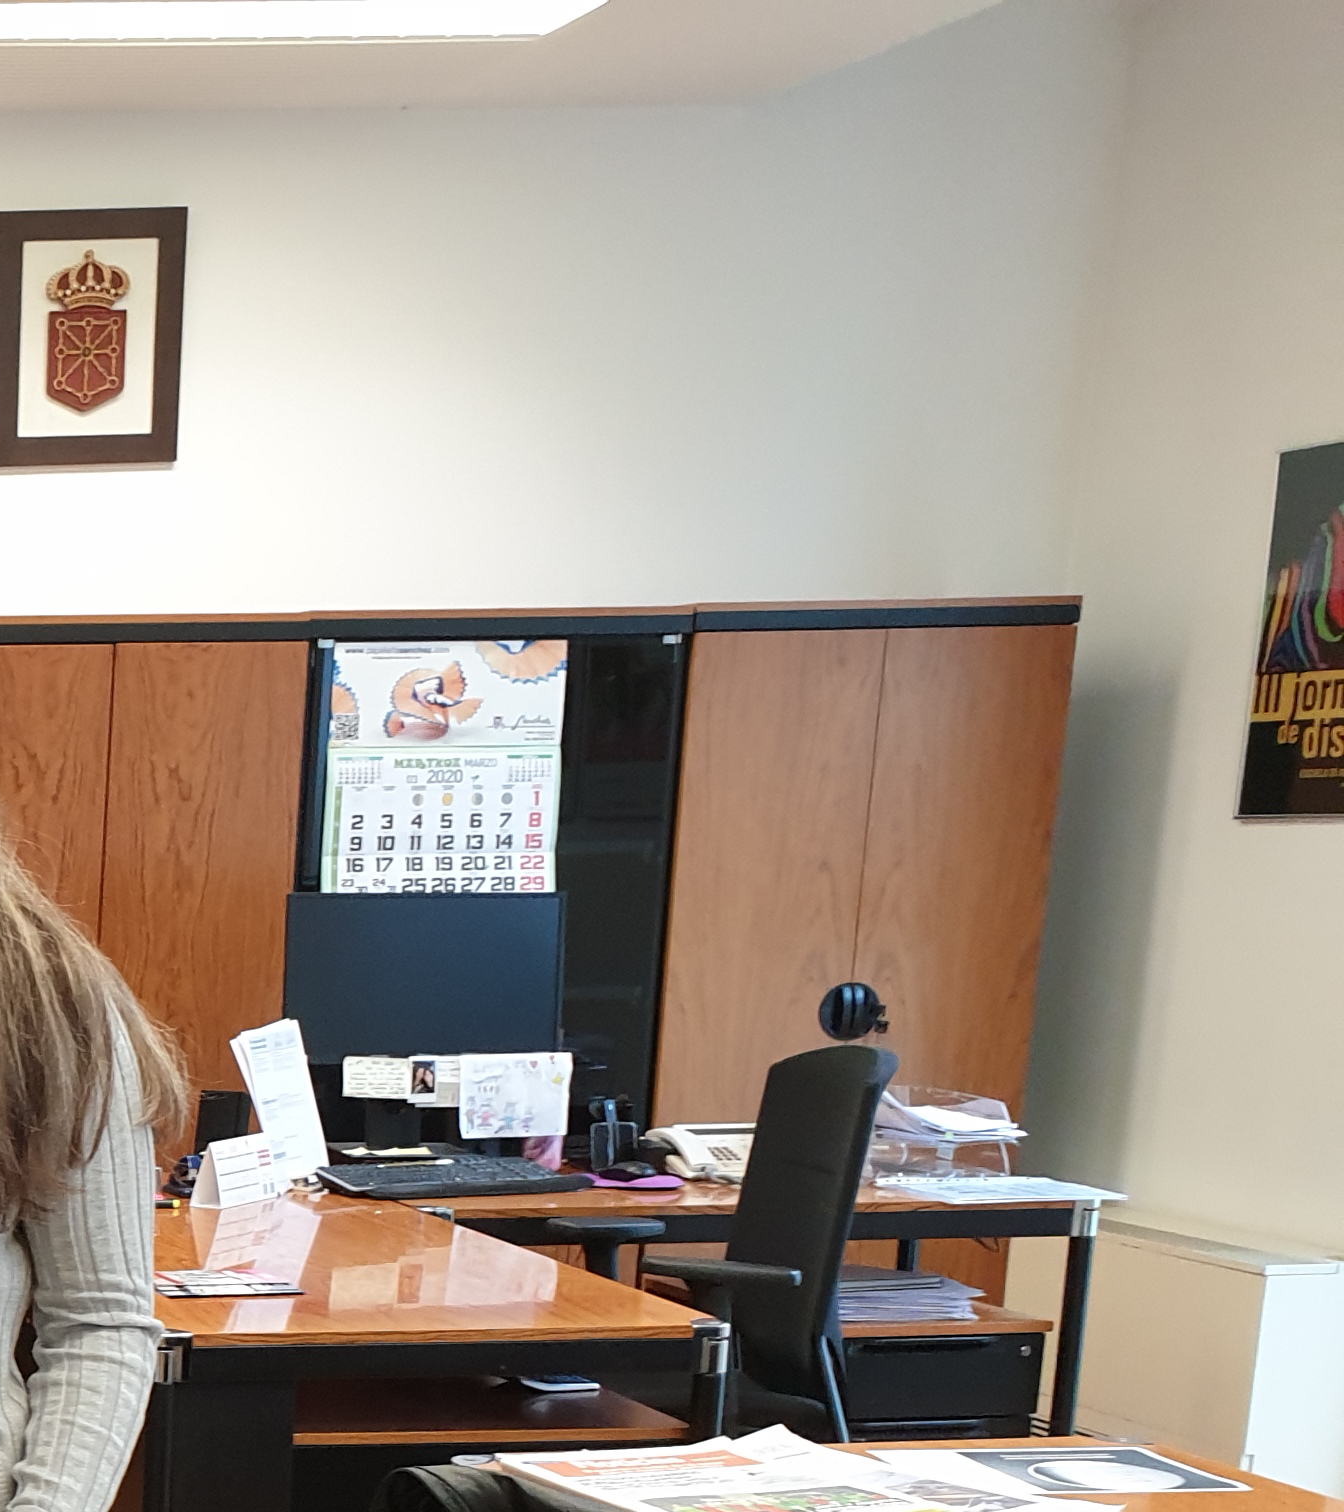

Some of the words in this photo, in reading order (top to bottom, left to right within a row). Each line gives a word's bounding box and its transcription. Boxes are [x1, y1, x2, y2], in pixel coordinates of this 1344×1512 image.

[1277, 719, 1300, 744] de
[427, 769, 463, 784] 2020
[351, 815, 364, 830] 2
[381, 814, 394, 829] 3
[411, 814, 423, 829] 4
[440, 813, 453, 829] 5
[469, 813, 483, 828] 6
[500, 813, 512, 828] 7
[529, 813, 541, 827] 8
[349, 836, 363, 851] 9
[377, 836, 395, 851] 10
[410, 835, 422, 851] 11
[436, 835, 455, 850] 12
[466, 835, 484, 850] 13
[495, 835, 513, 849] 14
[525, 835, 542, 849] 15
[346, 858, 364, 873] 16
[376, 857, 393, 872] 17
[405, 857, 423, 871] 18
[435, 856, 453, 871] 19
[462, 856, 486, 871] 20
[494, 855, 512, 870] 21
[520, 855, 544, 870] 22
[402, 878, 426, 892] 25
[431, 877, 456, 892] 26
[461, 877, 486, 892] 27
[491, 876, 514, 892] 28
[520, 876, 544, 891] 29
